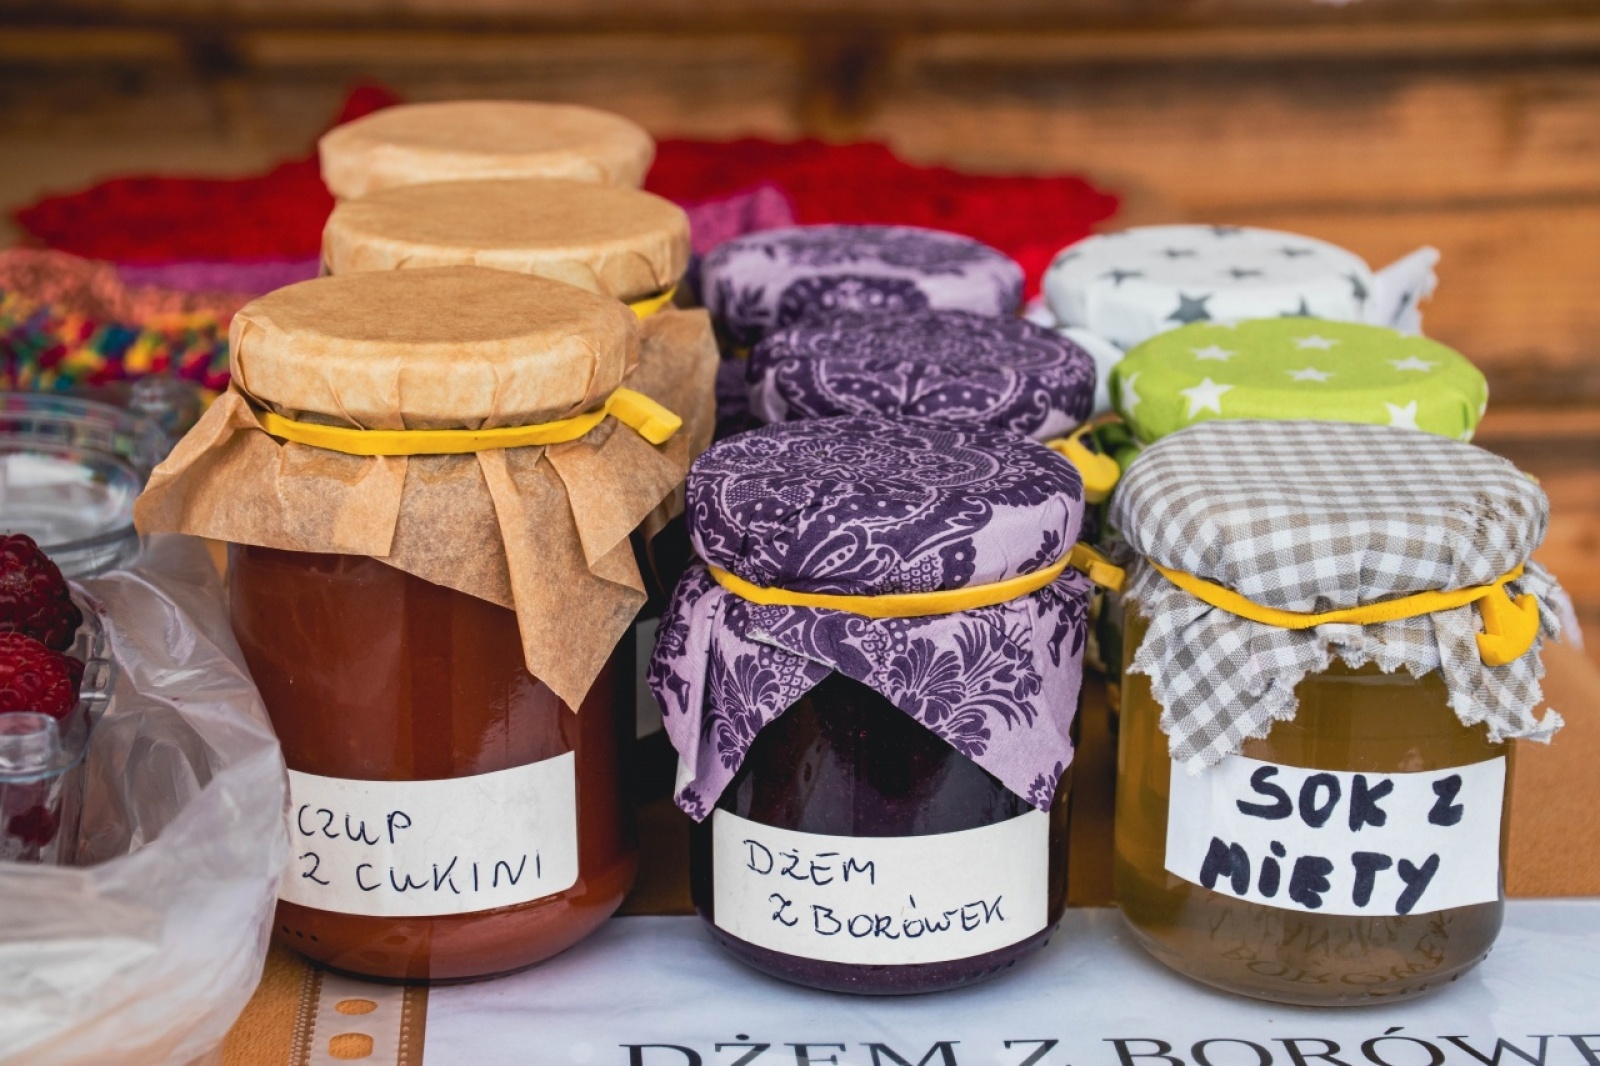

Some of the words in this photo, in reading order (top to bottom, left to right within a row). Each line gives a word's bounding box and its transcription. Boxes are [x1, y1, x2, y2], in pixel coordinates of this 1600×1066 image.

[1236, 765, 1394, 832] SOK
[743, 839, 876, 885] DŻEM
[769, 893, 798, 926] Z
[810, 894, 1005, 939] BORÓWEK
[619, 1033, 960, 1066] DŻEM
[1003, 1038, 1059, 1066] Z
